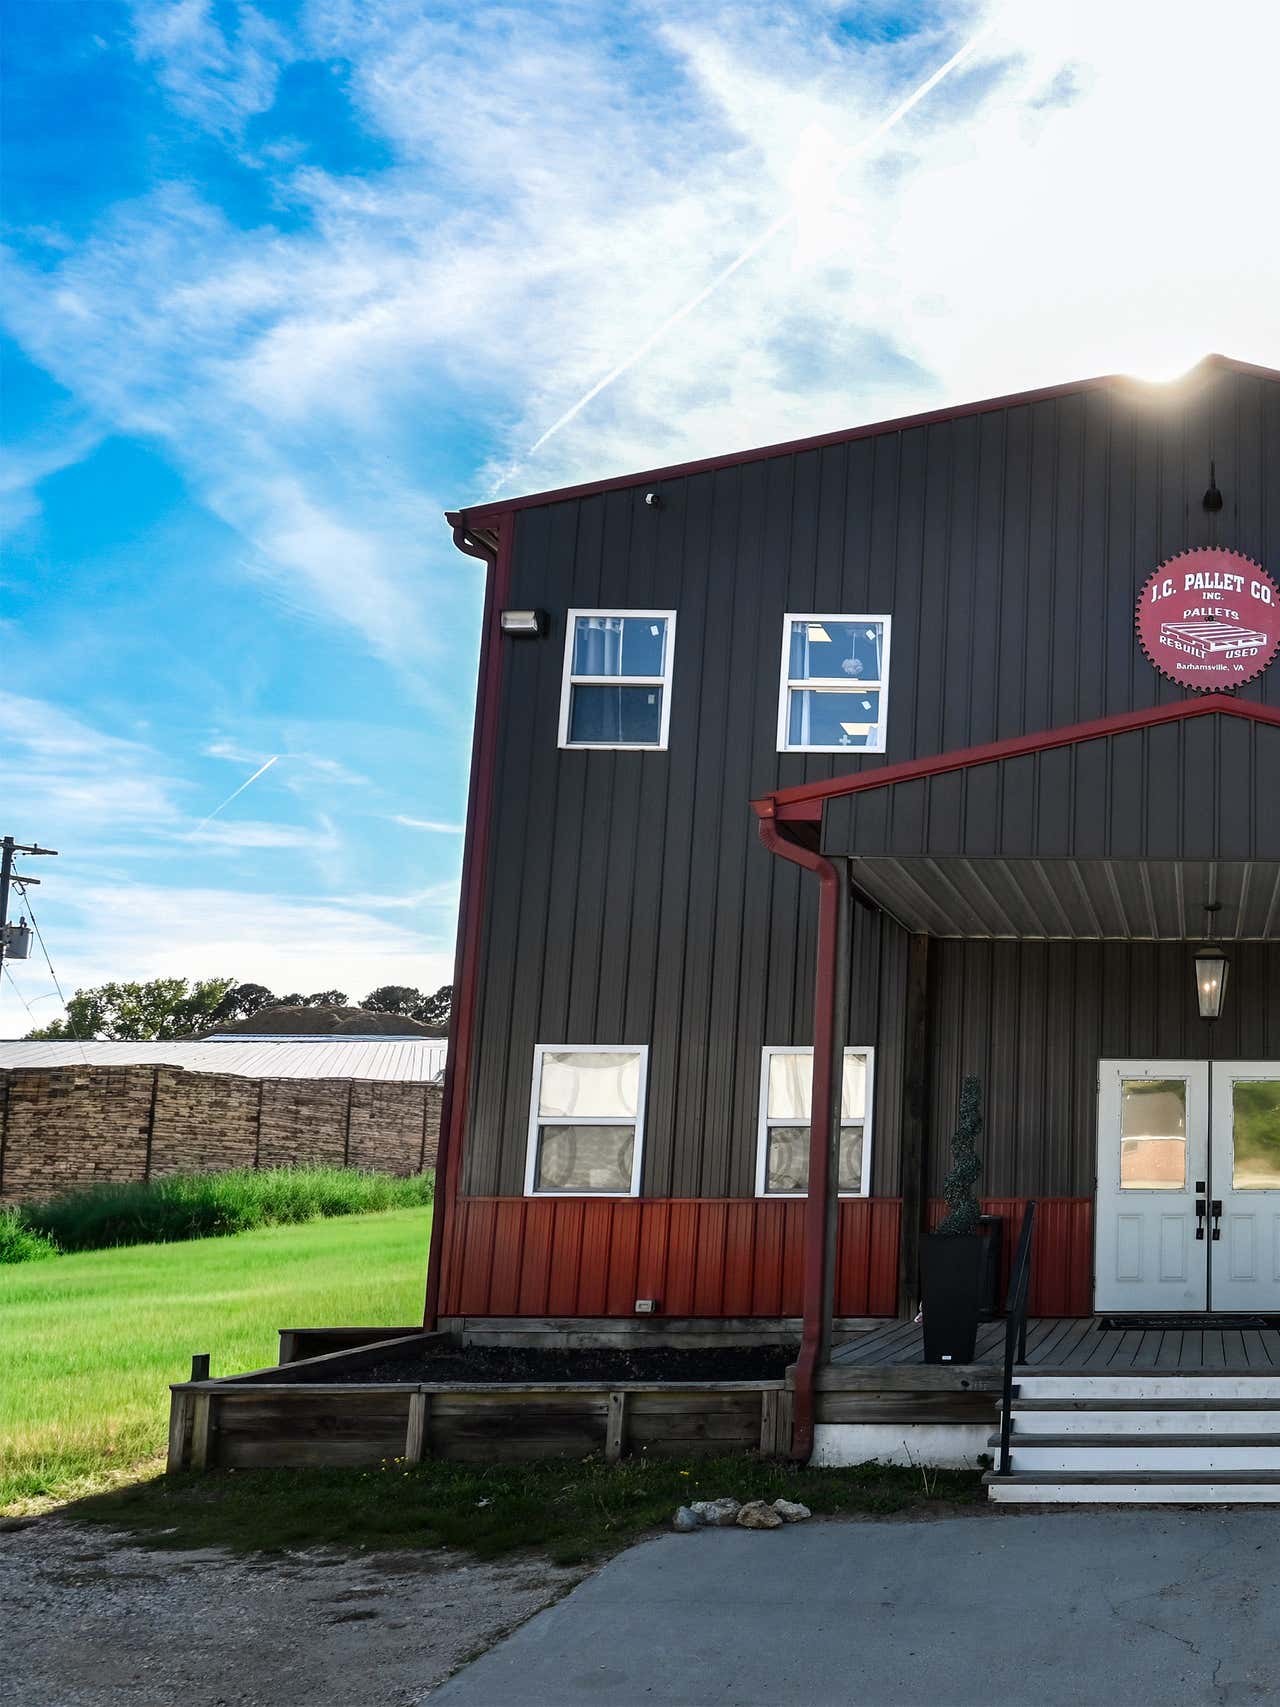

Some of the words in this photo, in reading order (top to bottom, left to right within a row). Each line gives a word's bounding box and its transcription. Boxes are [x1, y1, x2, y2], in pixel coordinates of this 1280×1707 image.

[1151, 578, 1177, 603] J.C.
[1184, 572, 1245, 592] PALLET
[1250, 580, 1276, 607] CO.
[1202, 591, 1225, 600] INC.
[1183, 607, 1240, 620] PALLETS
[1159, 635, 1207, 659] REBUILT
[1225, 647, 1258, 659] USED
